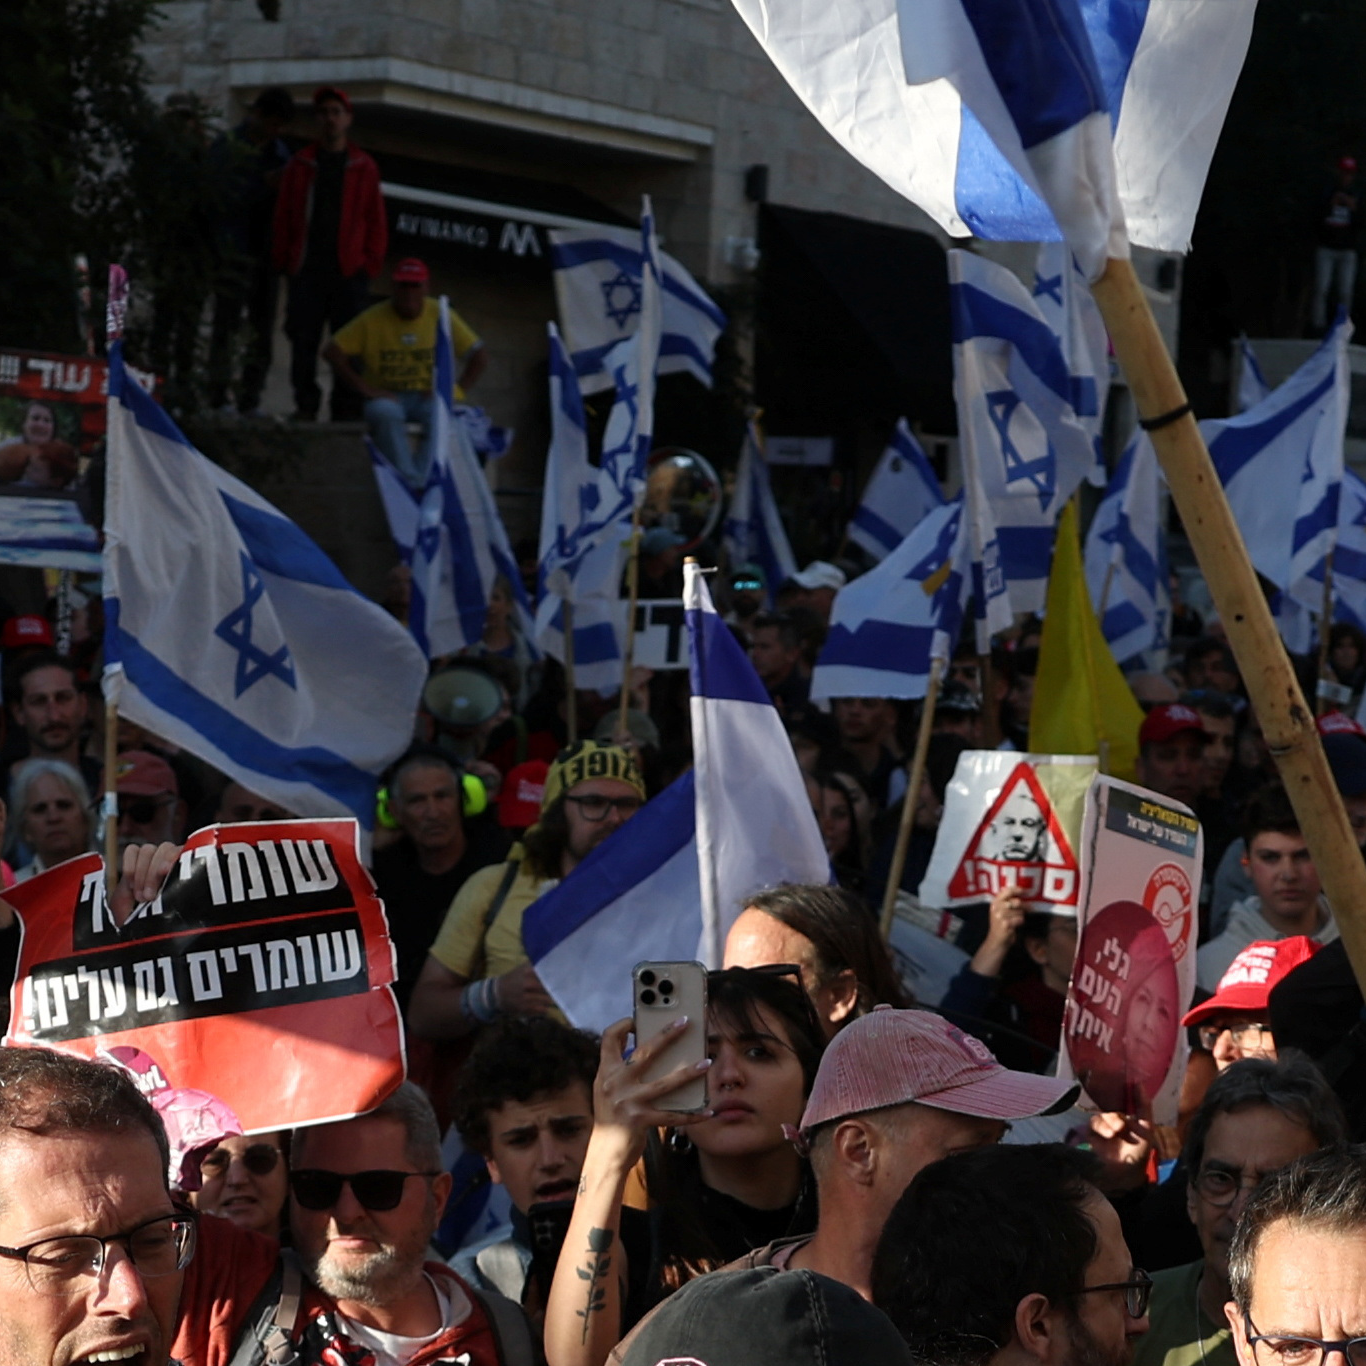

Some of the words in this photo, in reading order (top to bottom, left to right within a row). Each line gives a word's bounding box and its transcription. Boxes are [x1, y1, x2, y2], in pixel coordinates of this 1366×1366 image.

[26, 357, 91, 393] עוד
[1126, 812, 1153, 833] ישראל
[178, 838, 339, 907] שומרי
[965, 858, 1075, 900] סכנה!
[134, 954, 180, 1012] גם
[187, 928, 362, 1002] שומרים
[1095, 935, 1131, 982] גלי,
[23, 962, 128, 1031] עלינו!
[1078, 964, 1123, 1017] העם
[1065, 994, 1117, 1053] איתך
